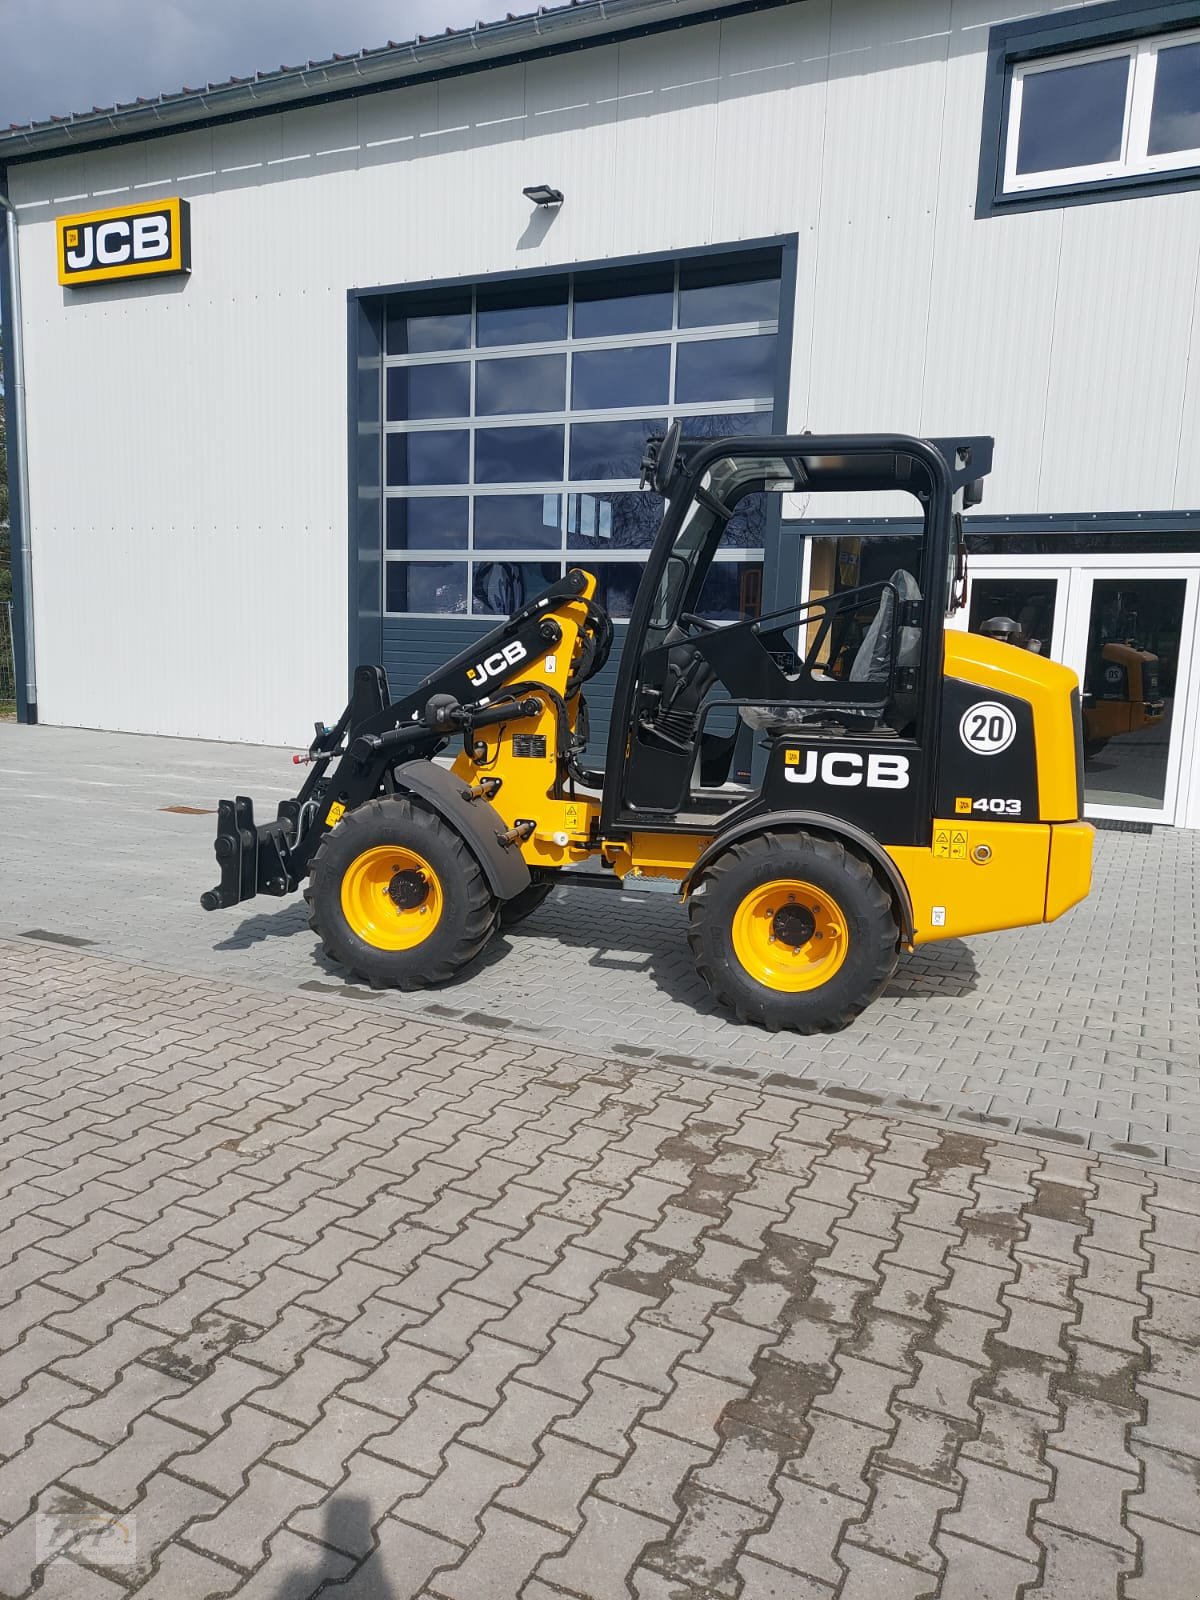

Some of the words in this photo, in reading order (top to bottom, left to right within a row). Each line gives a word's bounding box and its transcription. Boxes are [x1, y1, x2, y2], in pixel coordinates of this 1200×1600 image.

[67, 215, 169, 269] JCB
[470, 640, 527, 687] JCB
[970, 714, 1005, 742] 20
[784, 750, 910, 789] JCB
[972, 798, 1022, 813] 403
